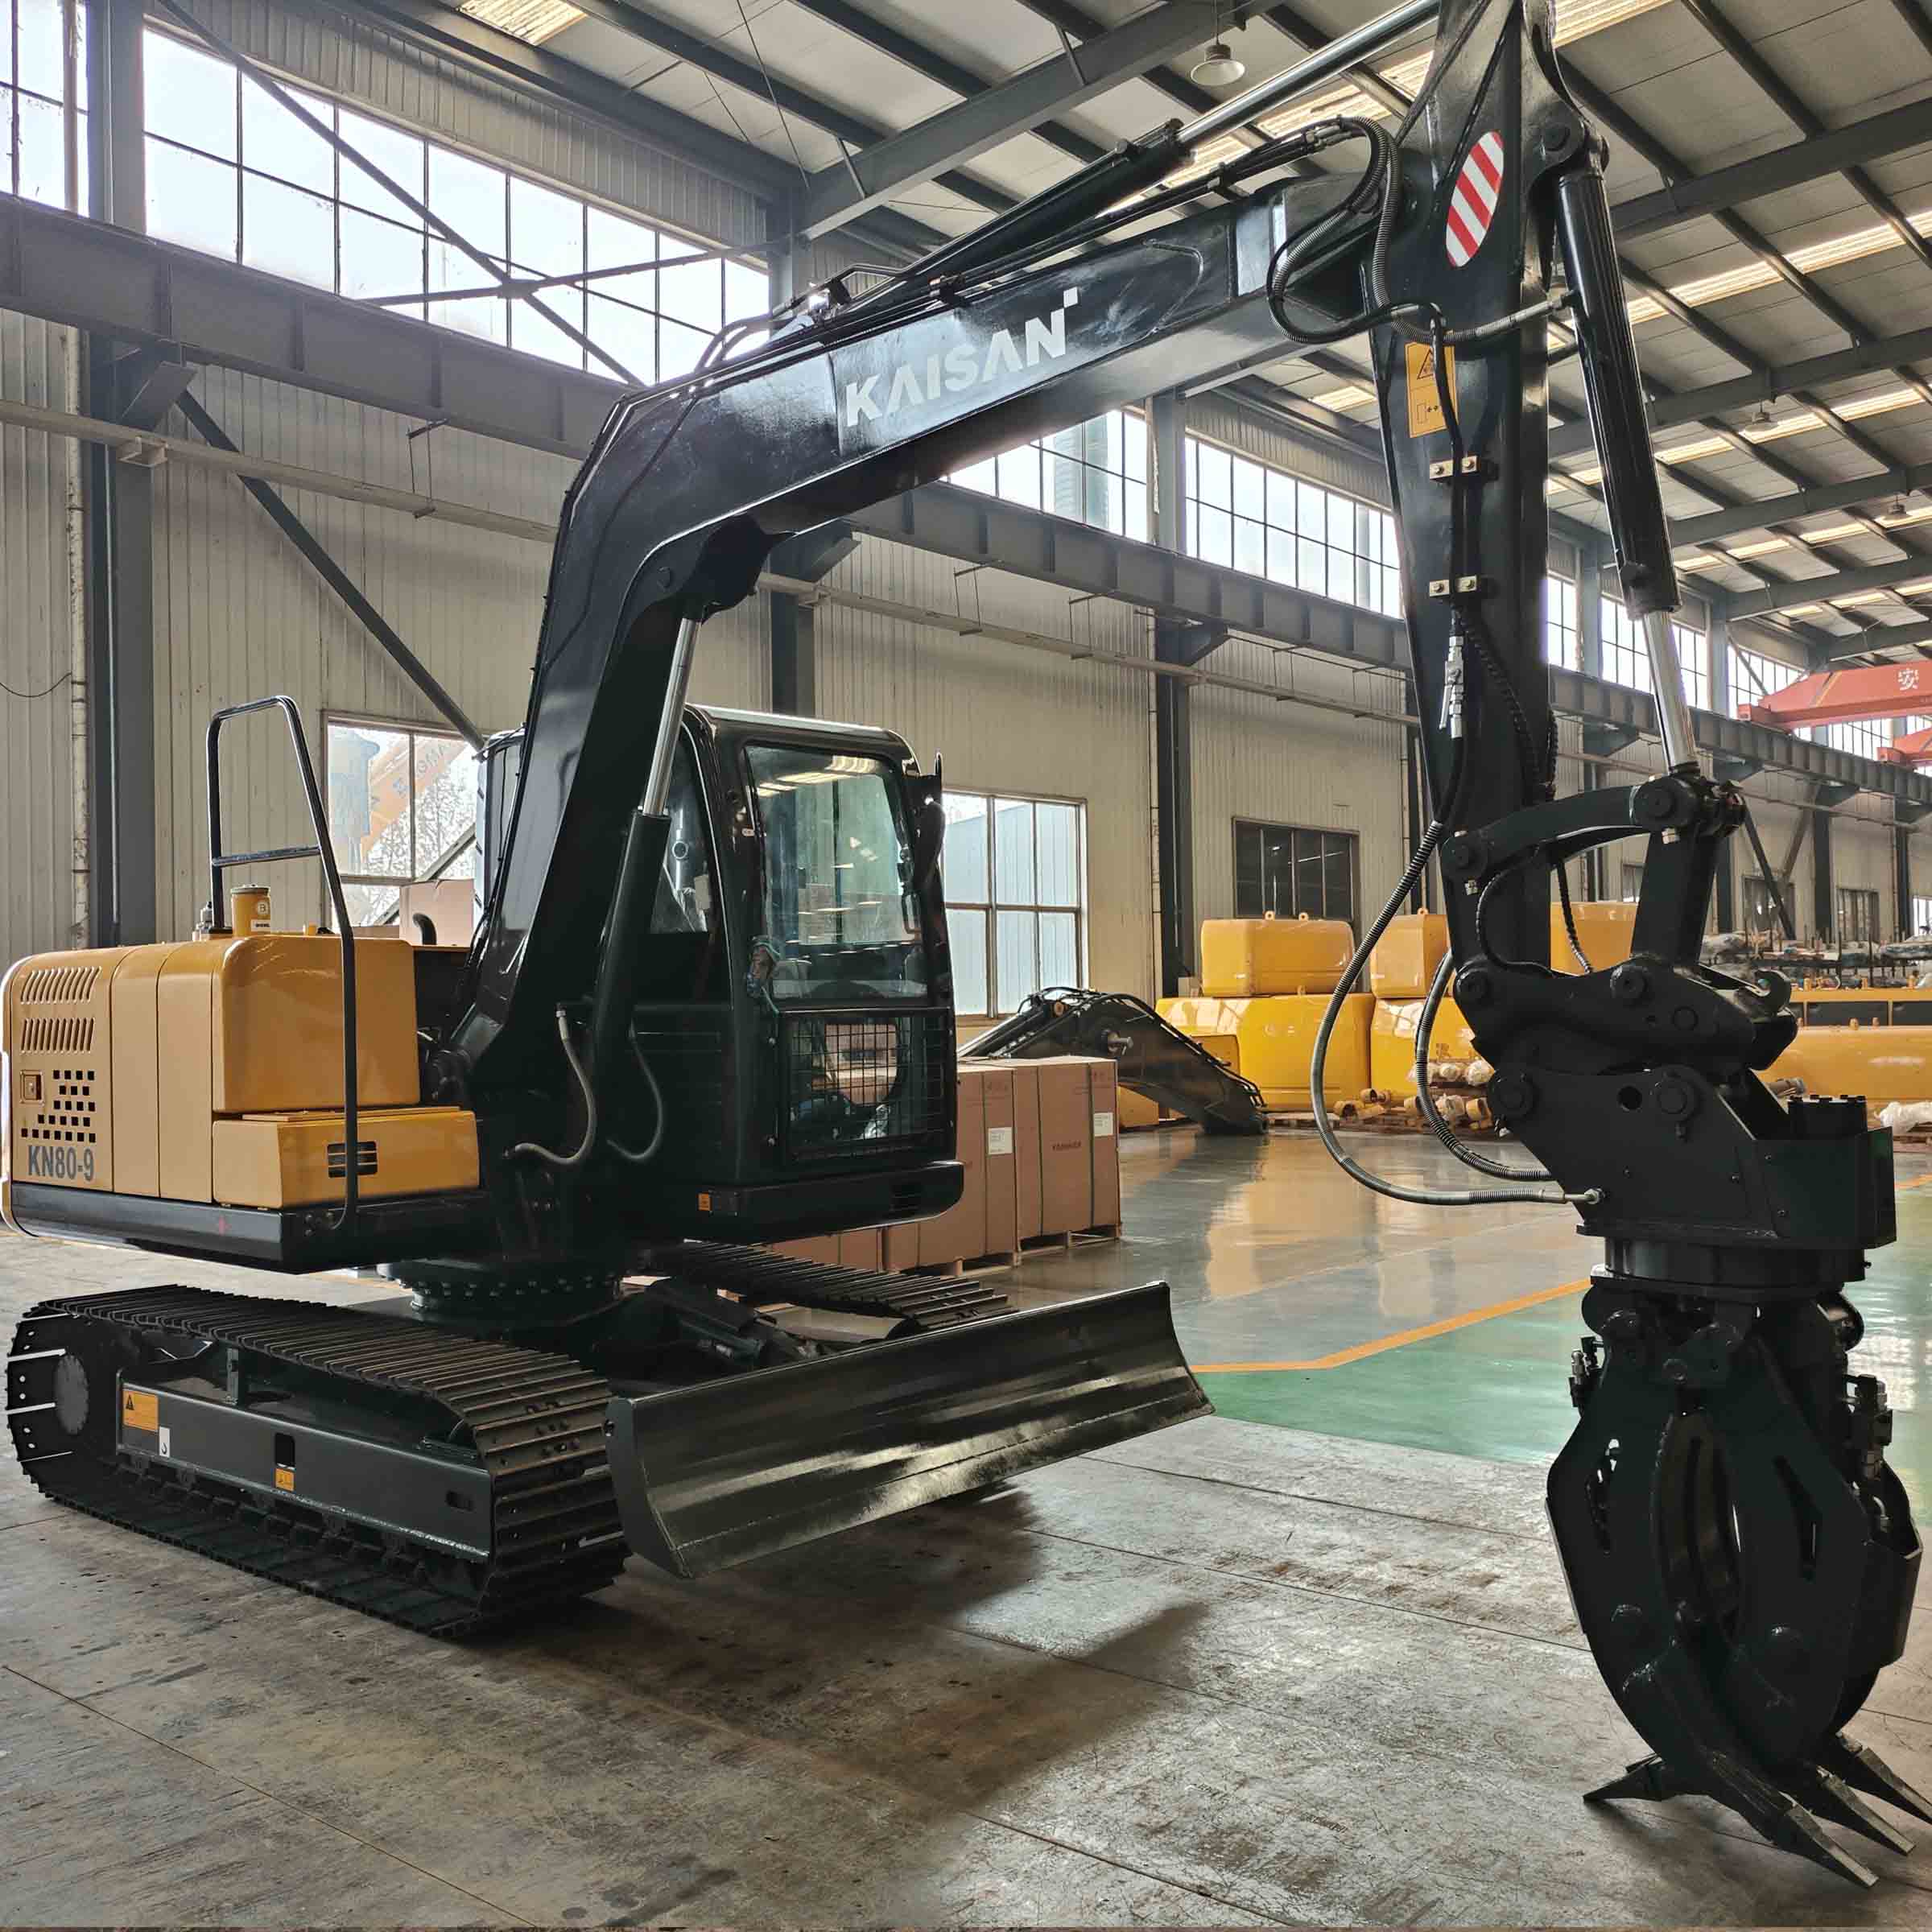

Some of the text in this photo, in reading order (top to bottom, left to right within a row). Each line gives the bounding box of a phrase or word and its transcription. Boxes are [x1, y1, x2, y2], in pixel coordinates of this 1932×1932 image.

[845, 308, 1067, 427] KAISAN
[1897, 667, 1919, 691] 安
[28, 1145, 94, 1182] KN80-9
